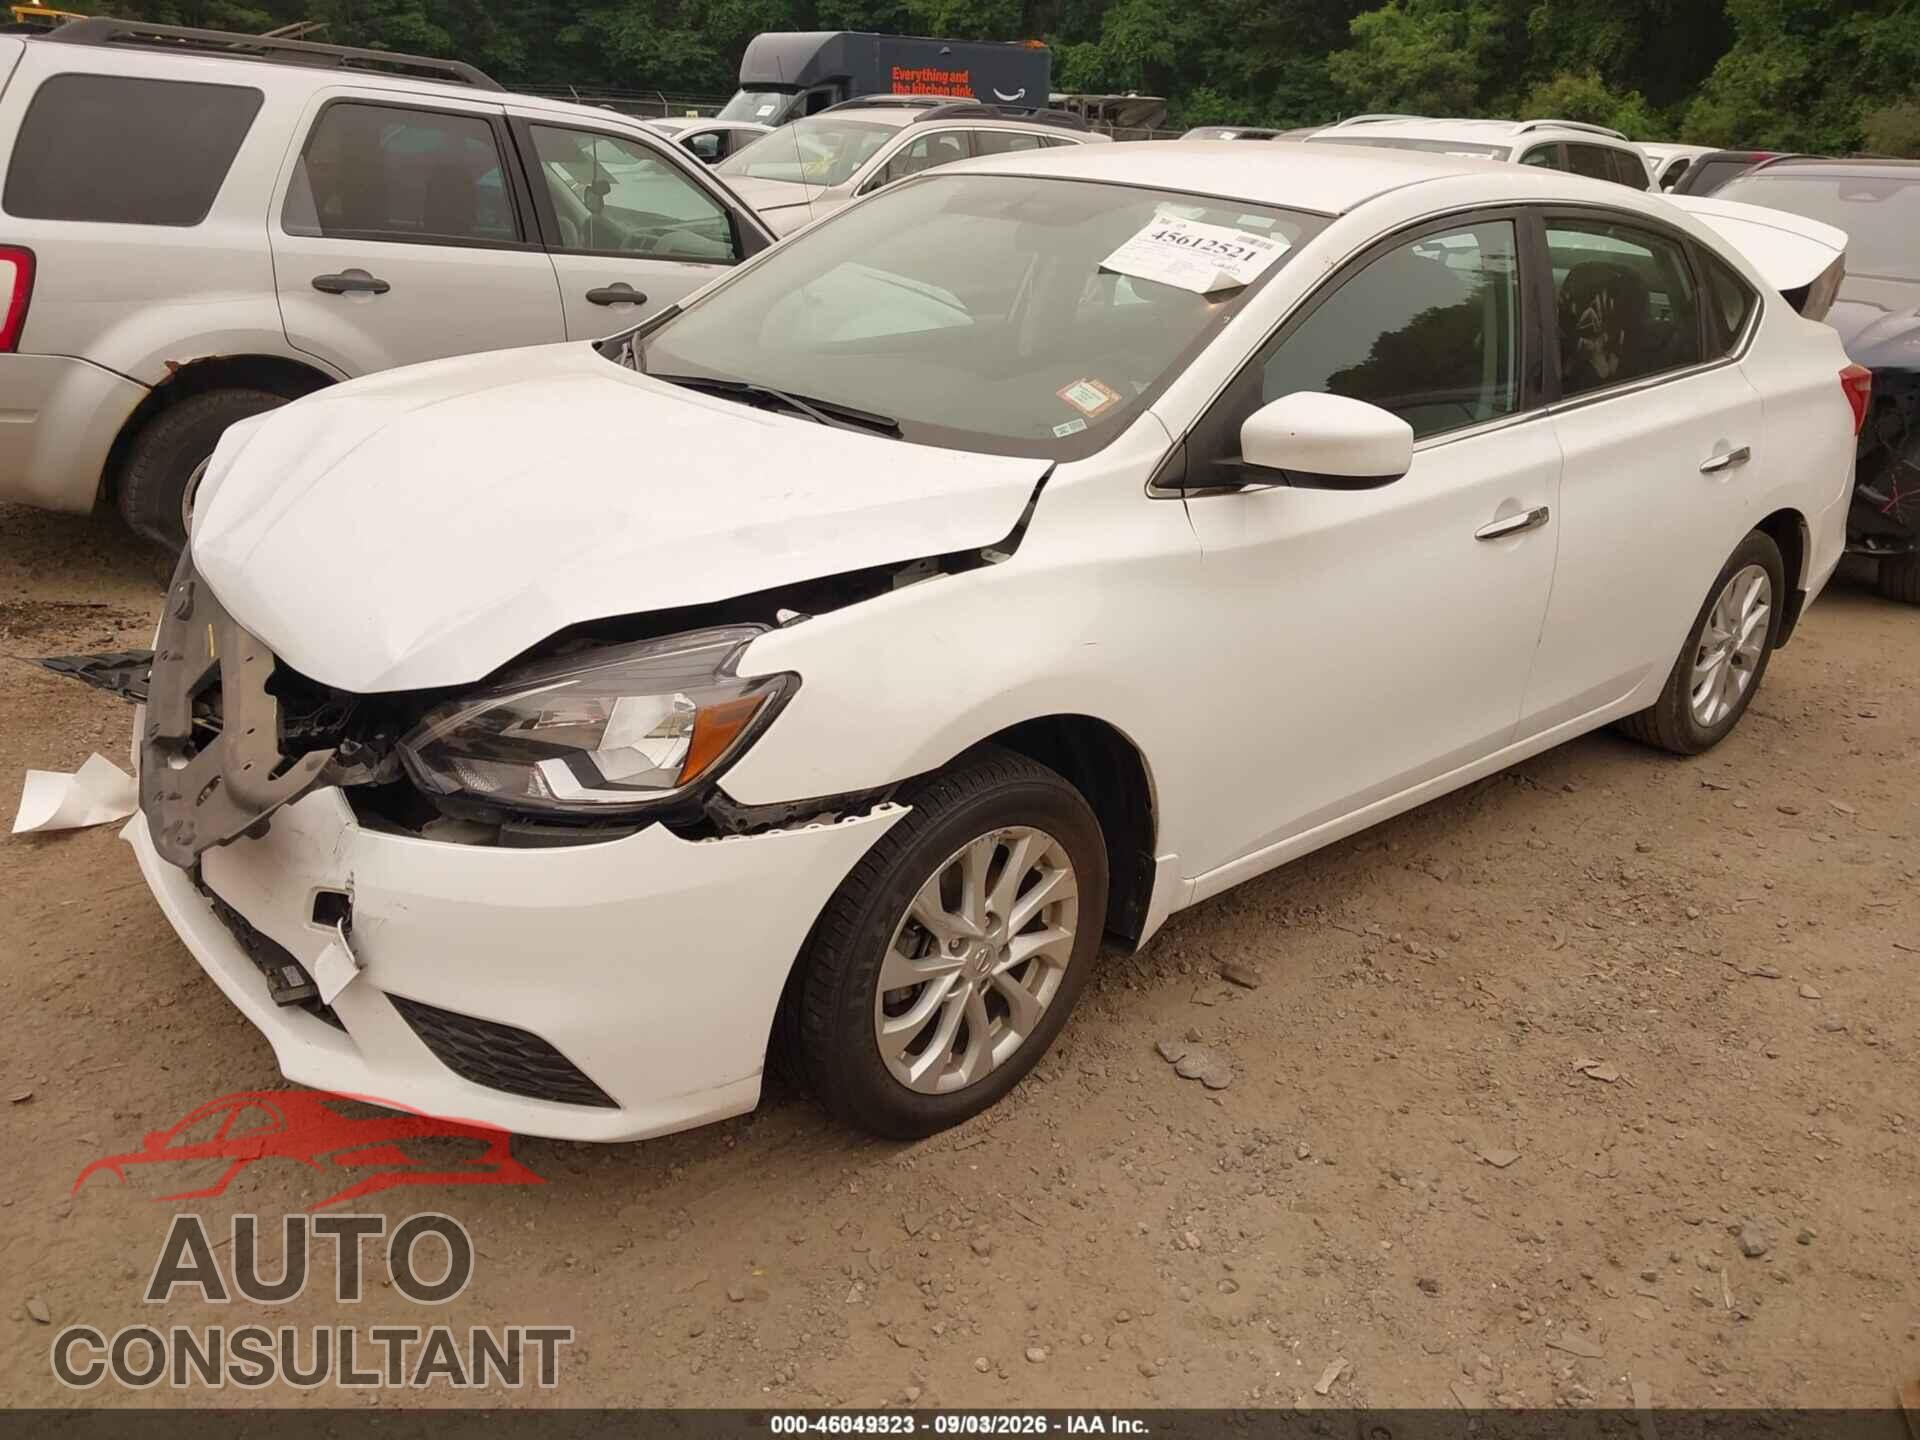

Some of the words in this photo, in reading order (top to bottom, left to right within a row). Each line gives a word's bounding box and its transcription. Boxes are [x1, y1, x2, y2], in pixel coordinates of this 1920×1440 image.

[892, 67, 949, 84] Everything
[950, 70, 968, 83] and
[893, 83, 910, 96] the
[911, 82, 950, 96] kitchen
[1152, 230, 1257, 262] 45612521
